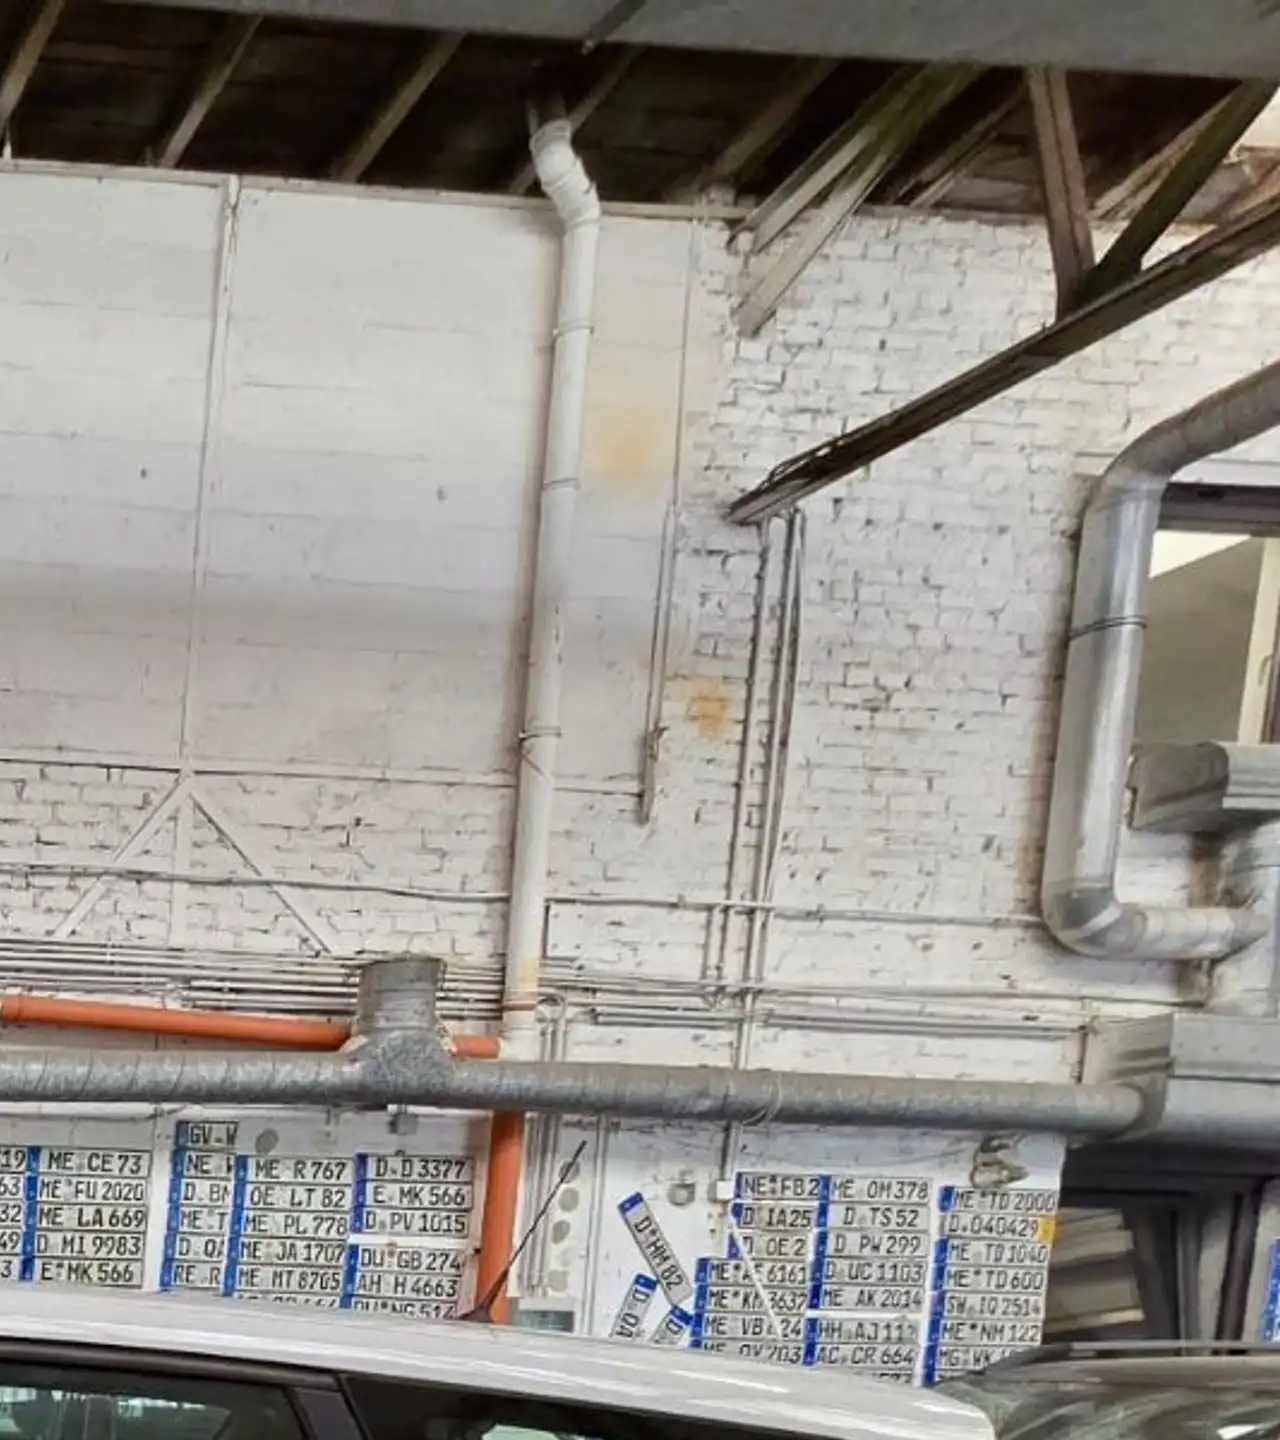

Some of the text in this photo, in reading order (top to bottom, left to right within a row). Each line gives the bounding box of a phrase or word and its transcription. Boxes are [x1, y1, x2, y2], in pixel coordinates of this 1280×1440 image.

[48, 1151, 74, 1170] ME
[418, 1159, 465, 1180] 3377
[39, 1178, 62, 1198] ME
[102, 1181, 144, 1201] 2020
[429, 1187, 465, 1206] 566
[39, 1207, 64, 1225] ME
[109, 1209, 145, 1228] 669
[419, 1213, 465, 1232] 1015
[92, 1236, 141, 1255] 9983
[426, 1253, 460, 1270] 274
[97, 1263, 133, 1282] 566
[411, 1279, 457, 1297] 4663
